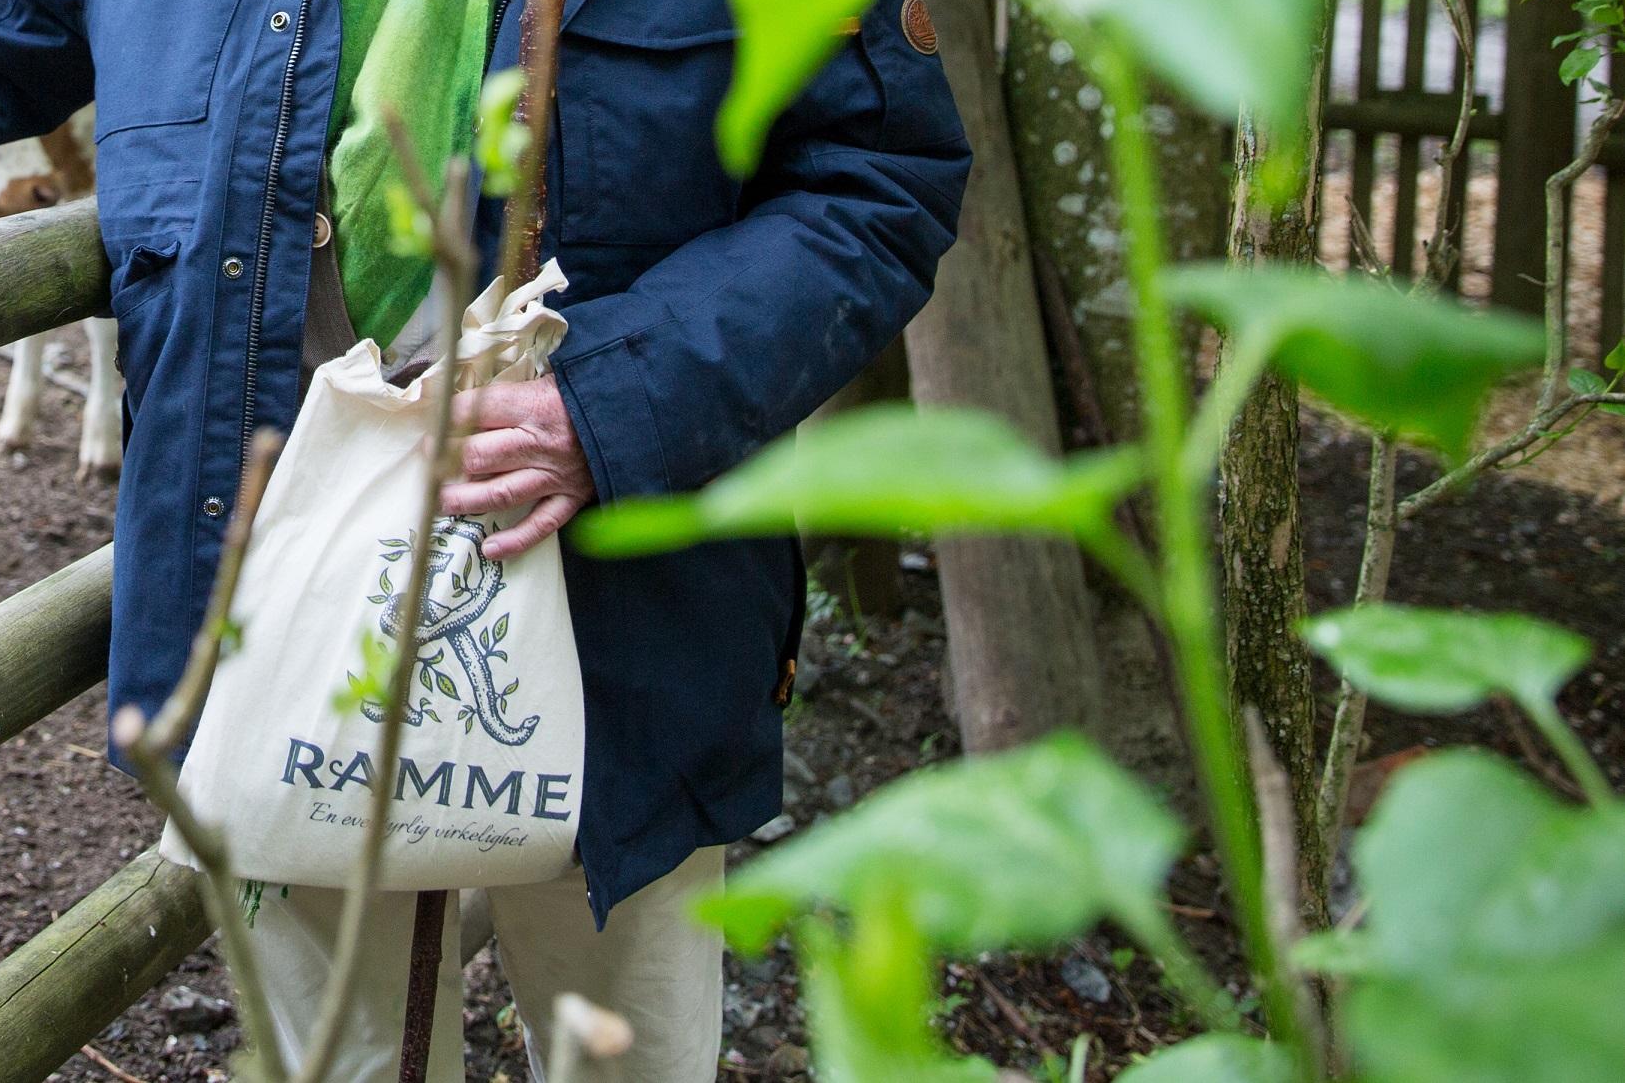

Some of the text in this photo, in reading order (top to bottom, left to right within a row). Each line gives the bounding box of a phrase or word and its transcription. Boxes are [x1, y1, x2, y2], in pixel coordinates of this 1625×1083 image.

[279, 737, 573, 822] RAMME
[309, 802, 529, 853] En eveyrlig virkelighet
